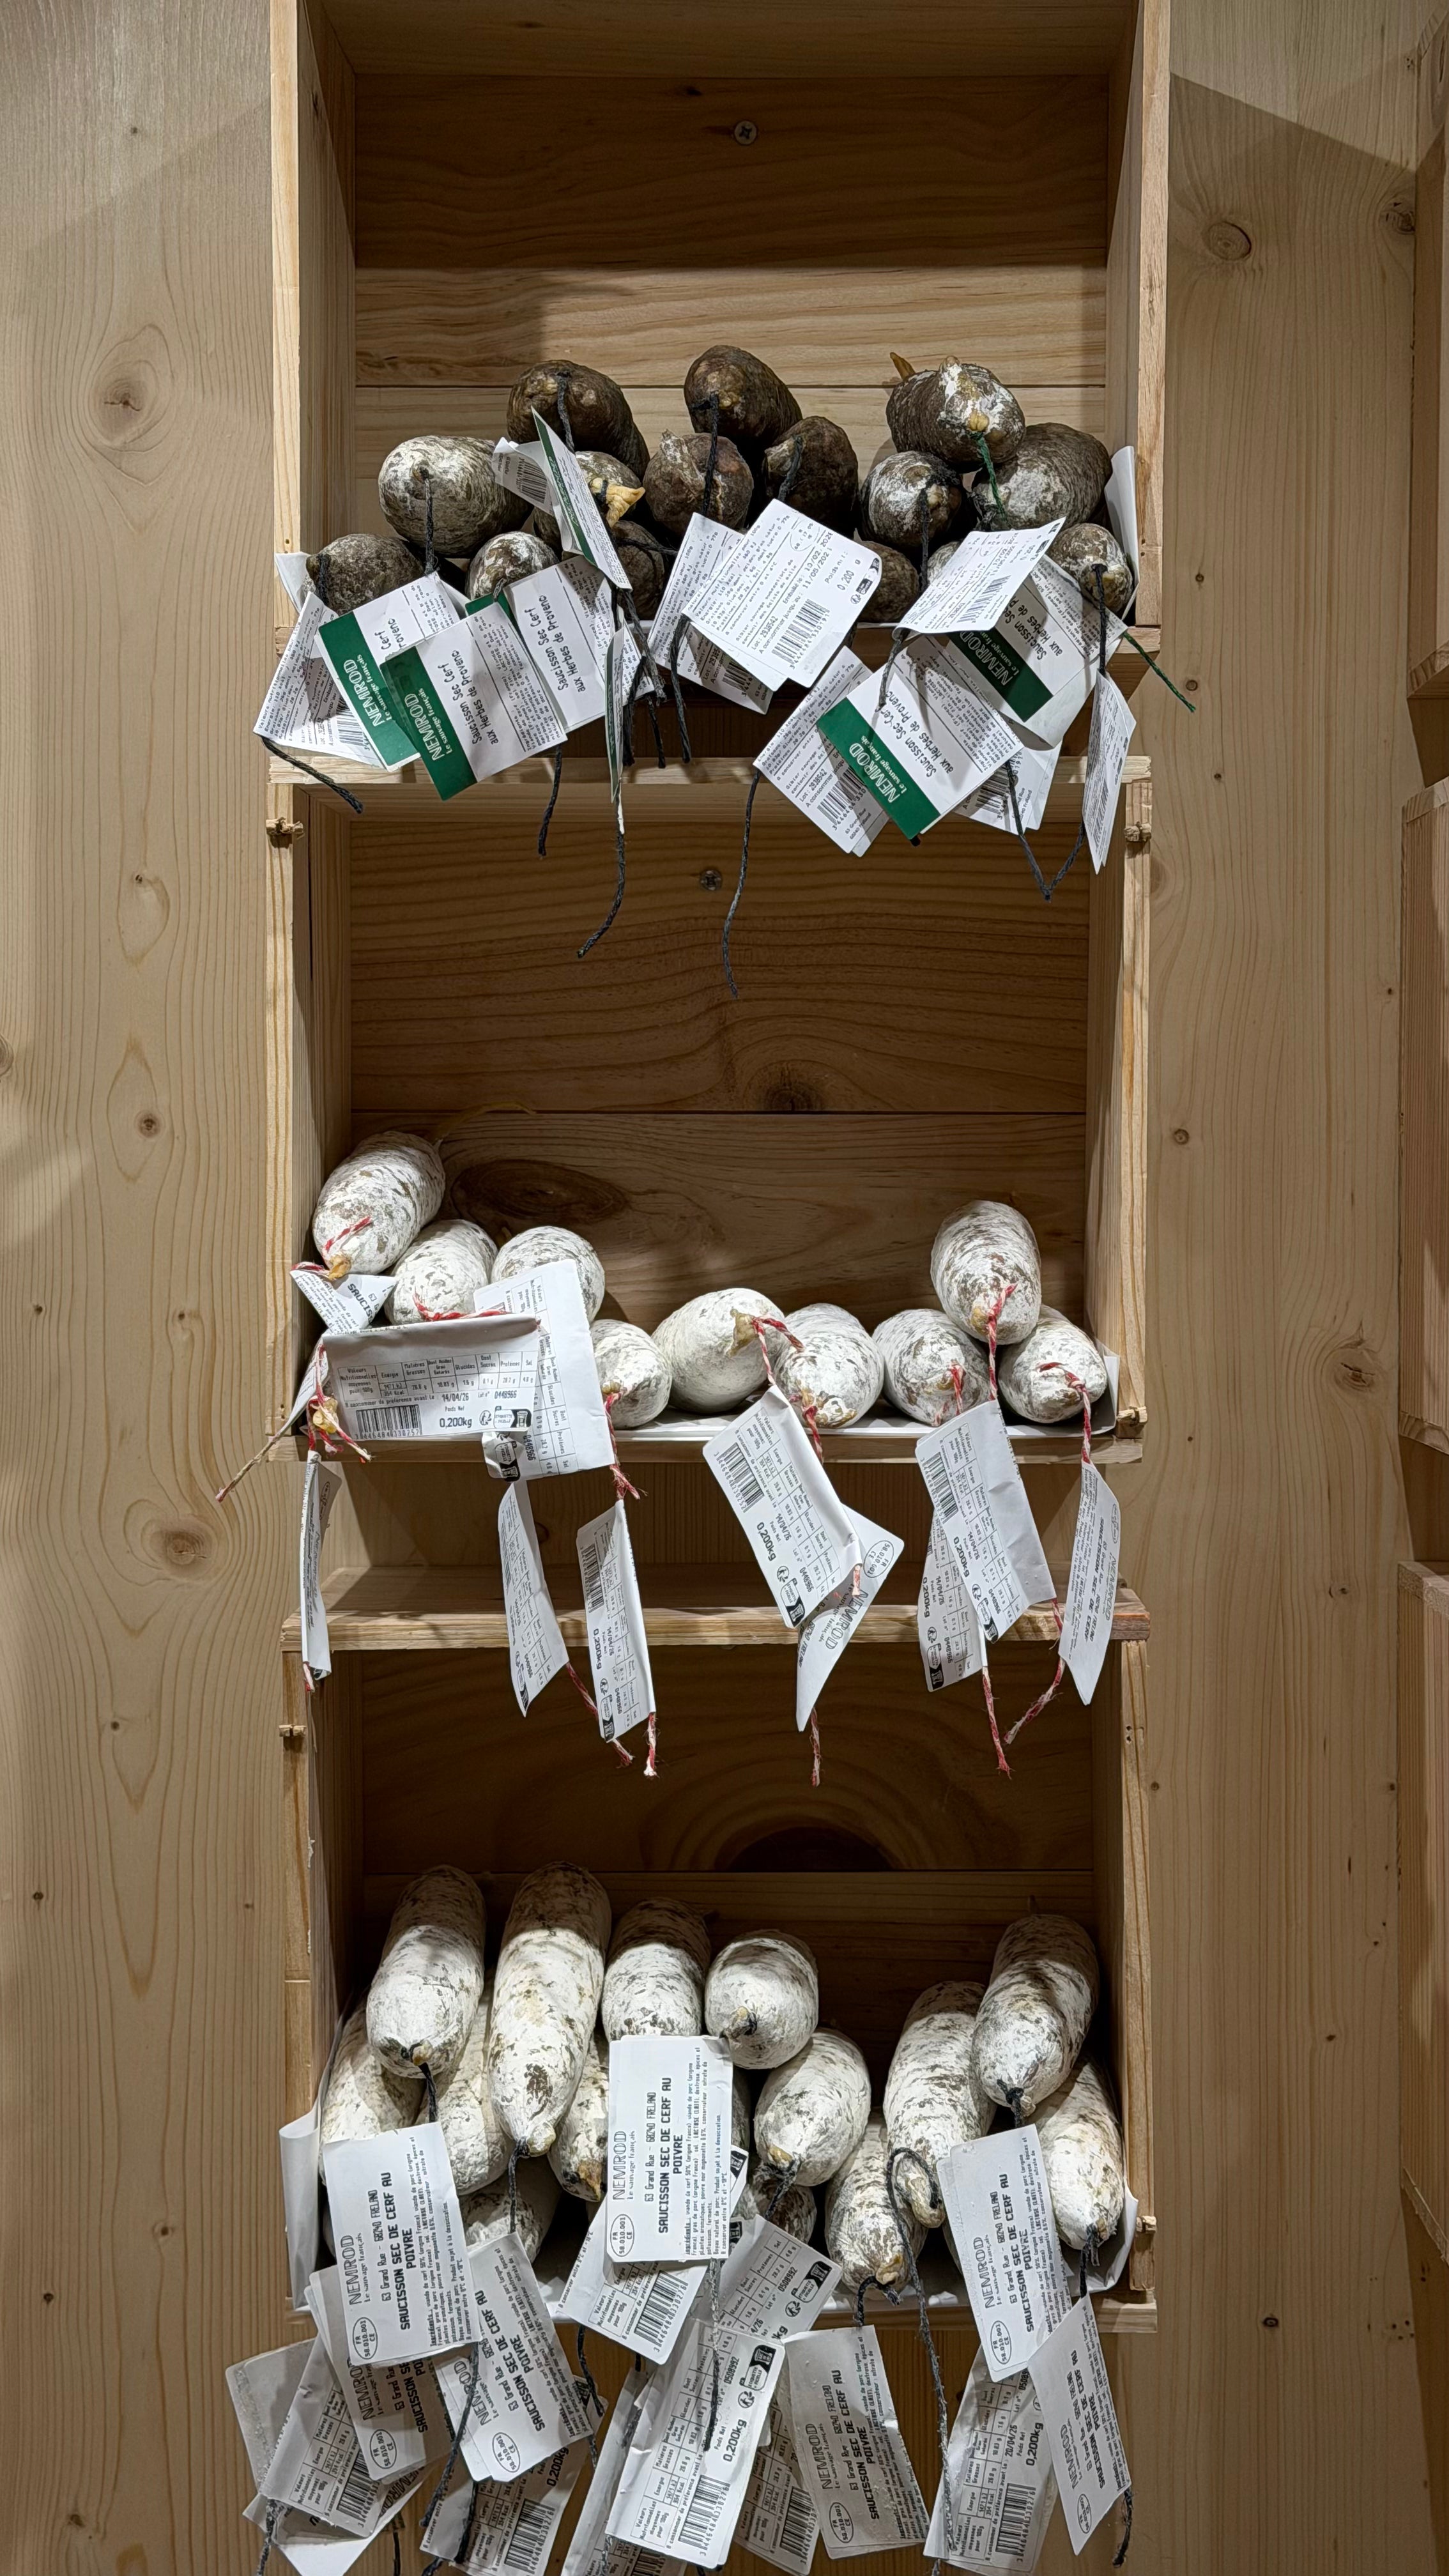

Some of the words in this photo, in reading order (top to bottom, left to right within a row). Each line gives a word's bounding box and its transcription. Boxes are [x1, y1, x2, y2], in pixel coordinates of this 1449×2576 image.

[824, 565, 839, 584] Poids
[523, 606, 542, 628] Cerf
[1016, 604, 1029, 617] de
[373, 629, 392, 650] Cerf
[387, 617, 407, 649] rovenc
[535, 628, 550, 646] Sec
[551, 631, 564, 644] de
[762, 617, 786, 650] consommer
[1012, 620, 1047, 661] Saucisson
[1025, 615, 1052, 644] Herbes
[557, 645, 579, 677] Herbes
[958, 625, 1013, 686] NEMROD
[990, 641, 1013, 667] sauvage
[1047, 640, 1063, 657] aux
[355, 653, 374, 683] français
[436, 661, 456, 683] Cerf
[542, 646, 570, 691] Saucisson
[1010, 665, 1020, 676] Le
[342, 657, 385, 727] NEMROD
[369, 682, 388, 710] sauvage
[449, 683, 464, 701] Sec
[465, 686, 478, 698] de
[572, 676, 586, 693] aux
[417, 687, 436, 716] français
[470, 698, 491, 730] Herbes
[383, 710, 392, 721] Le
[403, 692, 445, 760] NEMROD
[457, 700, 484, 744] Saucisson
[908, 720, 921, 733] de
[431, 715, 449, 744] sauvage
[485, 728, 499, 745] aux
[890, 722, 907, 740] Sec
[443, 743, 453, 754] Le
[859, 734, 882, 761] français
[902, 737, 937, 778] Saucisson
[916, 732, 942, 762] Herbes
[847, 741, 901, 803] NEMROD
[878, 758, 901, 785] sauvage
[939, 757, 954, 774] aux
[897, 782, 907, 793] Le
[347, 1365, 367, 1374] Valeurs
[441, 1392, 469, 1403] 14/04/26
[493, 1389, 518, 1400] 0448966
[439, 1416, 472, 1430] 0,200kg
[774, 1512, 793, 1541] 14/04/26
[754, 1521, 779, 1561] 0,200kg
[966, 1530, 981, 1560] 14/04/26
[868, 1550, 877, 1560] CE
[880, 1558, 889, 1568] FR
[952, 1536, 971, 1577] 0,200kg
[916, 1576, 933, 1618] 0,200kg
[932, 1575, 946, 1606] 14/04/26
[823, 1586, 869, 1650] NEMROD
[592, 1628, 603, 1670] 0,200kg
[661, 2077, 671, 2091] AU
[646, 2091, 656, 2119] FRELAND
[660, 2096, 671, 2123] CERF
[627, 2130, 636, 2159] français
[645, 2122, 656, 2142] 68240
[660, 2128, 671, 2142] DE
[611, 2130, 627, 2200] NEMROD
[645, 2154, 655, 2166] Rue
[659, 2146, 670, 2167] SEC
[672, 2134, 683, 2174] POIVRE
[380, 2171, 392, 2187] AU
[644, 2170, 655, 2189] Grand
[998, 2173, 1009, 2188] AU
[367, 2189, 381, 2218] FRELAND
[383, 2191, 397, 2220] CERF
[627, 2191, 634, 2200] Le
[644, 2193, 654, 2202] 63
[658, 2172, 670, 2233] SAUCISSON
[1001, 2193, 1014, 2221] CERF
[371, 2220, 384, 2242] 68240
[387, 2223, 399, 2239] DE
[611, 2230, 618, 2240] FR
[625, 2230, 633, 2240] CE
[1007, 2224, 1018, 2241] DE
[355, 2232, 365, 2262] français
[376, 2252, 387, 2266] Rue
[390, 2242, 402, 2264] SEC
[401, 2227, 417, 2269] POIVRE
[1010, 2243, 1022, 2266] SEC
[1018, 2228, 1033, 2270] POIVRE
[339, 2234, 362, 2305] NEMROD
[360, 2262, 369, 2292] sauvage
[378, 2268, 390, 2290] Grand
[777, 2266, 798, 2292] 0508992
[972, 2235, 995, 2308] NEMROD
[363, 2293, 371, 2303] Le
[381, 2291, 392, 2301] 63
[393, 2267, 411, 2330] SAUCISSON
[473, 2289, 488, 2306] AU
[1015, 2269, 1034, 2332] SAUCISSON
[480, 2307, 500, 2334] CERF
[353, 2334, 362, 2345] FR
[359, 2319, 371, 2358] 58.010.001
[368, 2331, 376, 2342] CE
[493, 2334, 509, 2351] DE
[502, 2351, 519, 2374] SEC
[509, 2334, 534, 2373] POIVRE
[1070, 2349, 1079, 2366] AU
[723, 2355, 740, 2384] 0508992
[831, 2368, 844, 2385] AU
[1073, 2368, 1085, 2394] CERF
[402, 2375, 428, 2433] SAUCISSON
[512, 2373, 546, 2432] SAUCISSON
[835, 2388, 850, 2416] CERF
[1080, 2395, 1089, 2411] DE
[1087, 2391, 1101, 2430] POIVRE
[843, 2419, 855, 2434] DE
[1084, 2412, 1093, 2432] SEC
[494, 2434, 517, 2472] 58.010.001
[721, 2418, 747, 2463] 0,200kg
[848, 2437, 862, 2458] SEC
[856, 2425, 876, 2465] POIVRE
[1004, 2423, 1018, 2457] 20/04/26
[1024, 2421, 1044, 2466] 0,200kg
[544, 2445, 569, 2487] 0,200kg
[804, 2422, 833, 2490] NEMROD
[1059, 2423, 1079, 2489] NEMROD
[1088, 2433, 1106, 2489] SAUCISSON
[855, 2460, 880, 2520] SAUCISSON
